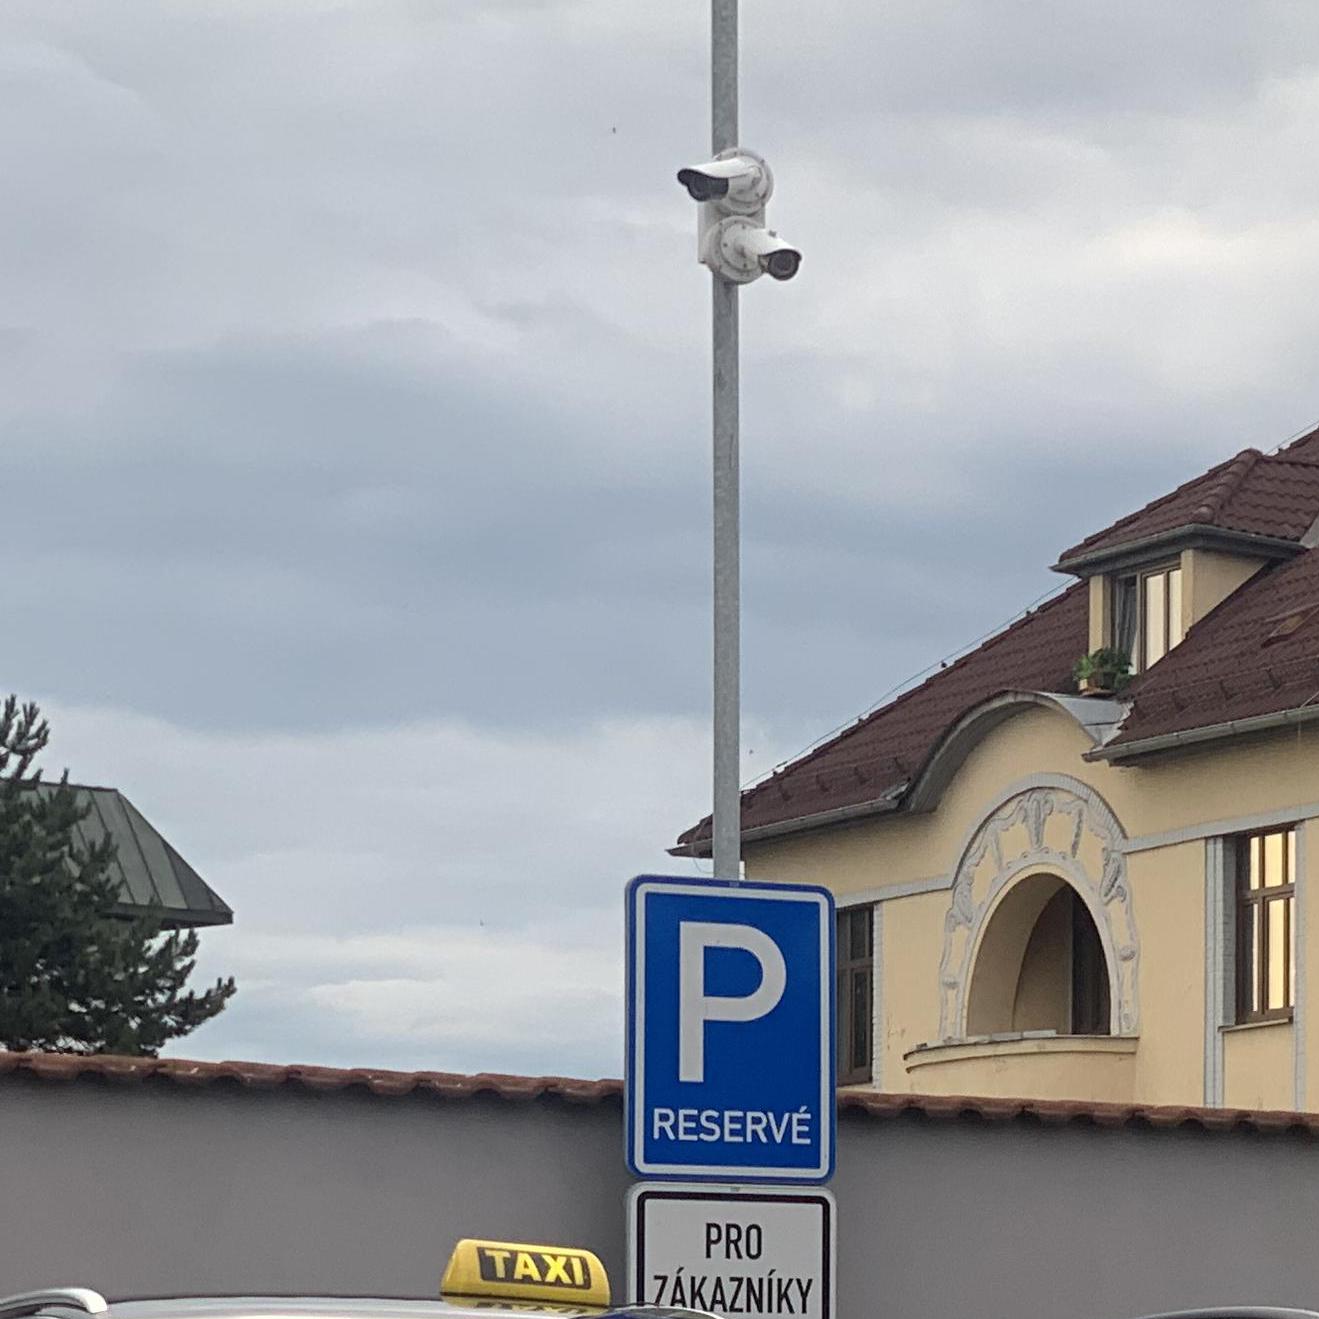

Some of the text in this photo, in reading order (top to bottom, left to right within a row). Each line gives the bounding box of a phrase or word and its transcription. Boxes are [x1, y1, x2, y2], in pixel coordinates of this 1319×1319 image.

[679, 921, 787, 1083] P
[653, 1106, 812, 1146] RESERVÉ
[705, 1222, 763, 1260] PRO
[484, 1249, 585, 1286] TAXI
[653, 1266, 814, 1315] ZÁKAZNÍKY
